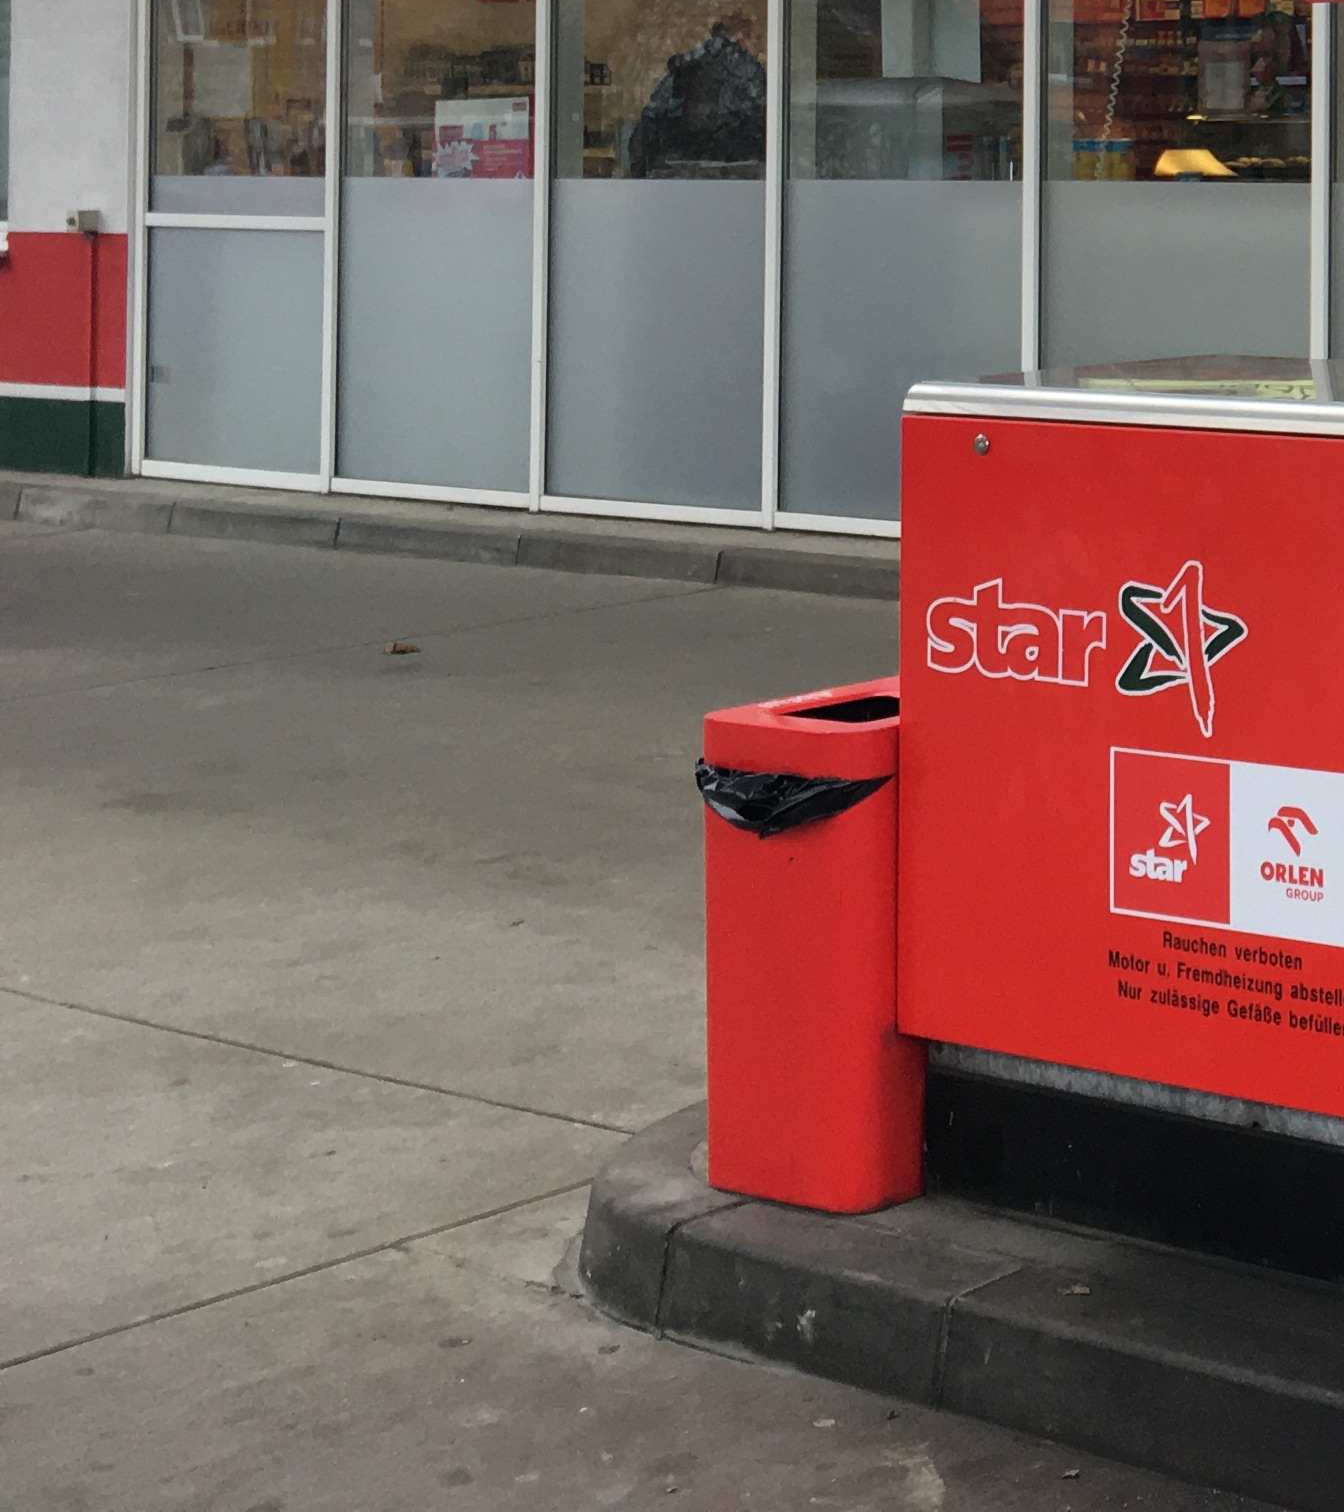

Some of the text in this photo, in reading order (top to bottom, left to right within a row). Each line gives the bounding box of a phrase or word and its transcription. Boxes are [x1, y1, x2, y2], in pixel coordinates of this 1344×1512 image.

[926, 578, 1107, 687] star
[1128, 848, 1188, 884] star
[1260, 861, 1324, 888] ORLEN
[1285, 887, 1324, 903] GROUP
[1163, 931, 1303, 970] Rauchen verboten
[1108, 950, 1150, 974] Motor
[1157, 963, 1170, 978] u.
[1177, 962, 1283, 1000] Fremdheizung
[1118, 979, 1142, 1001] Nur
[1150, 987, 1220, 1017] zulässige
[1227, 999, 1282, 1026] Gefäße
